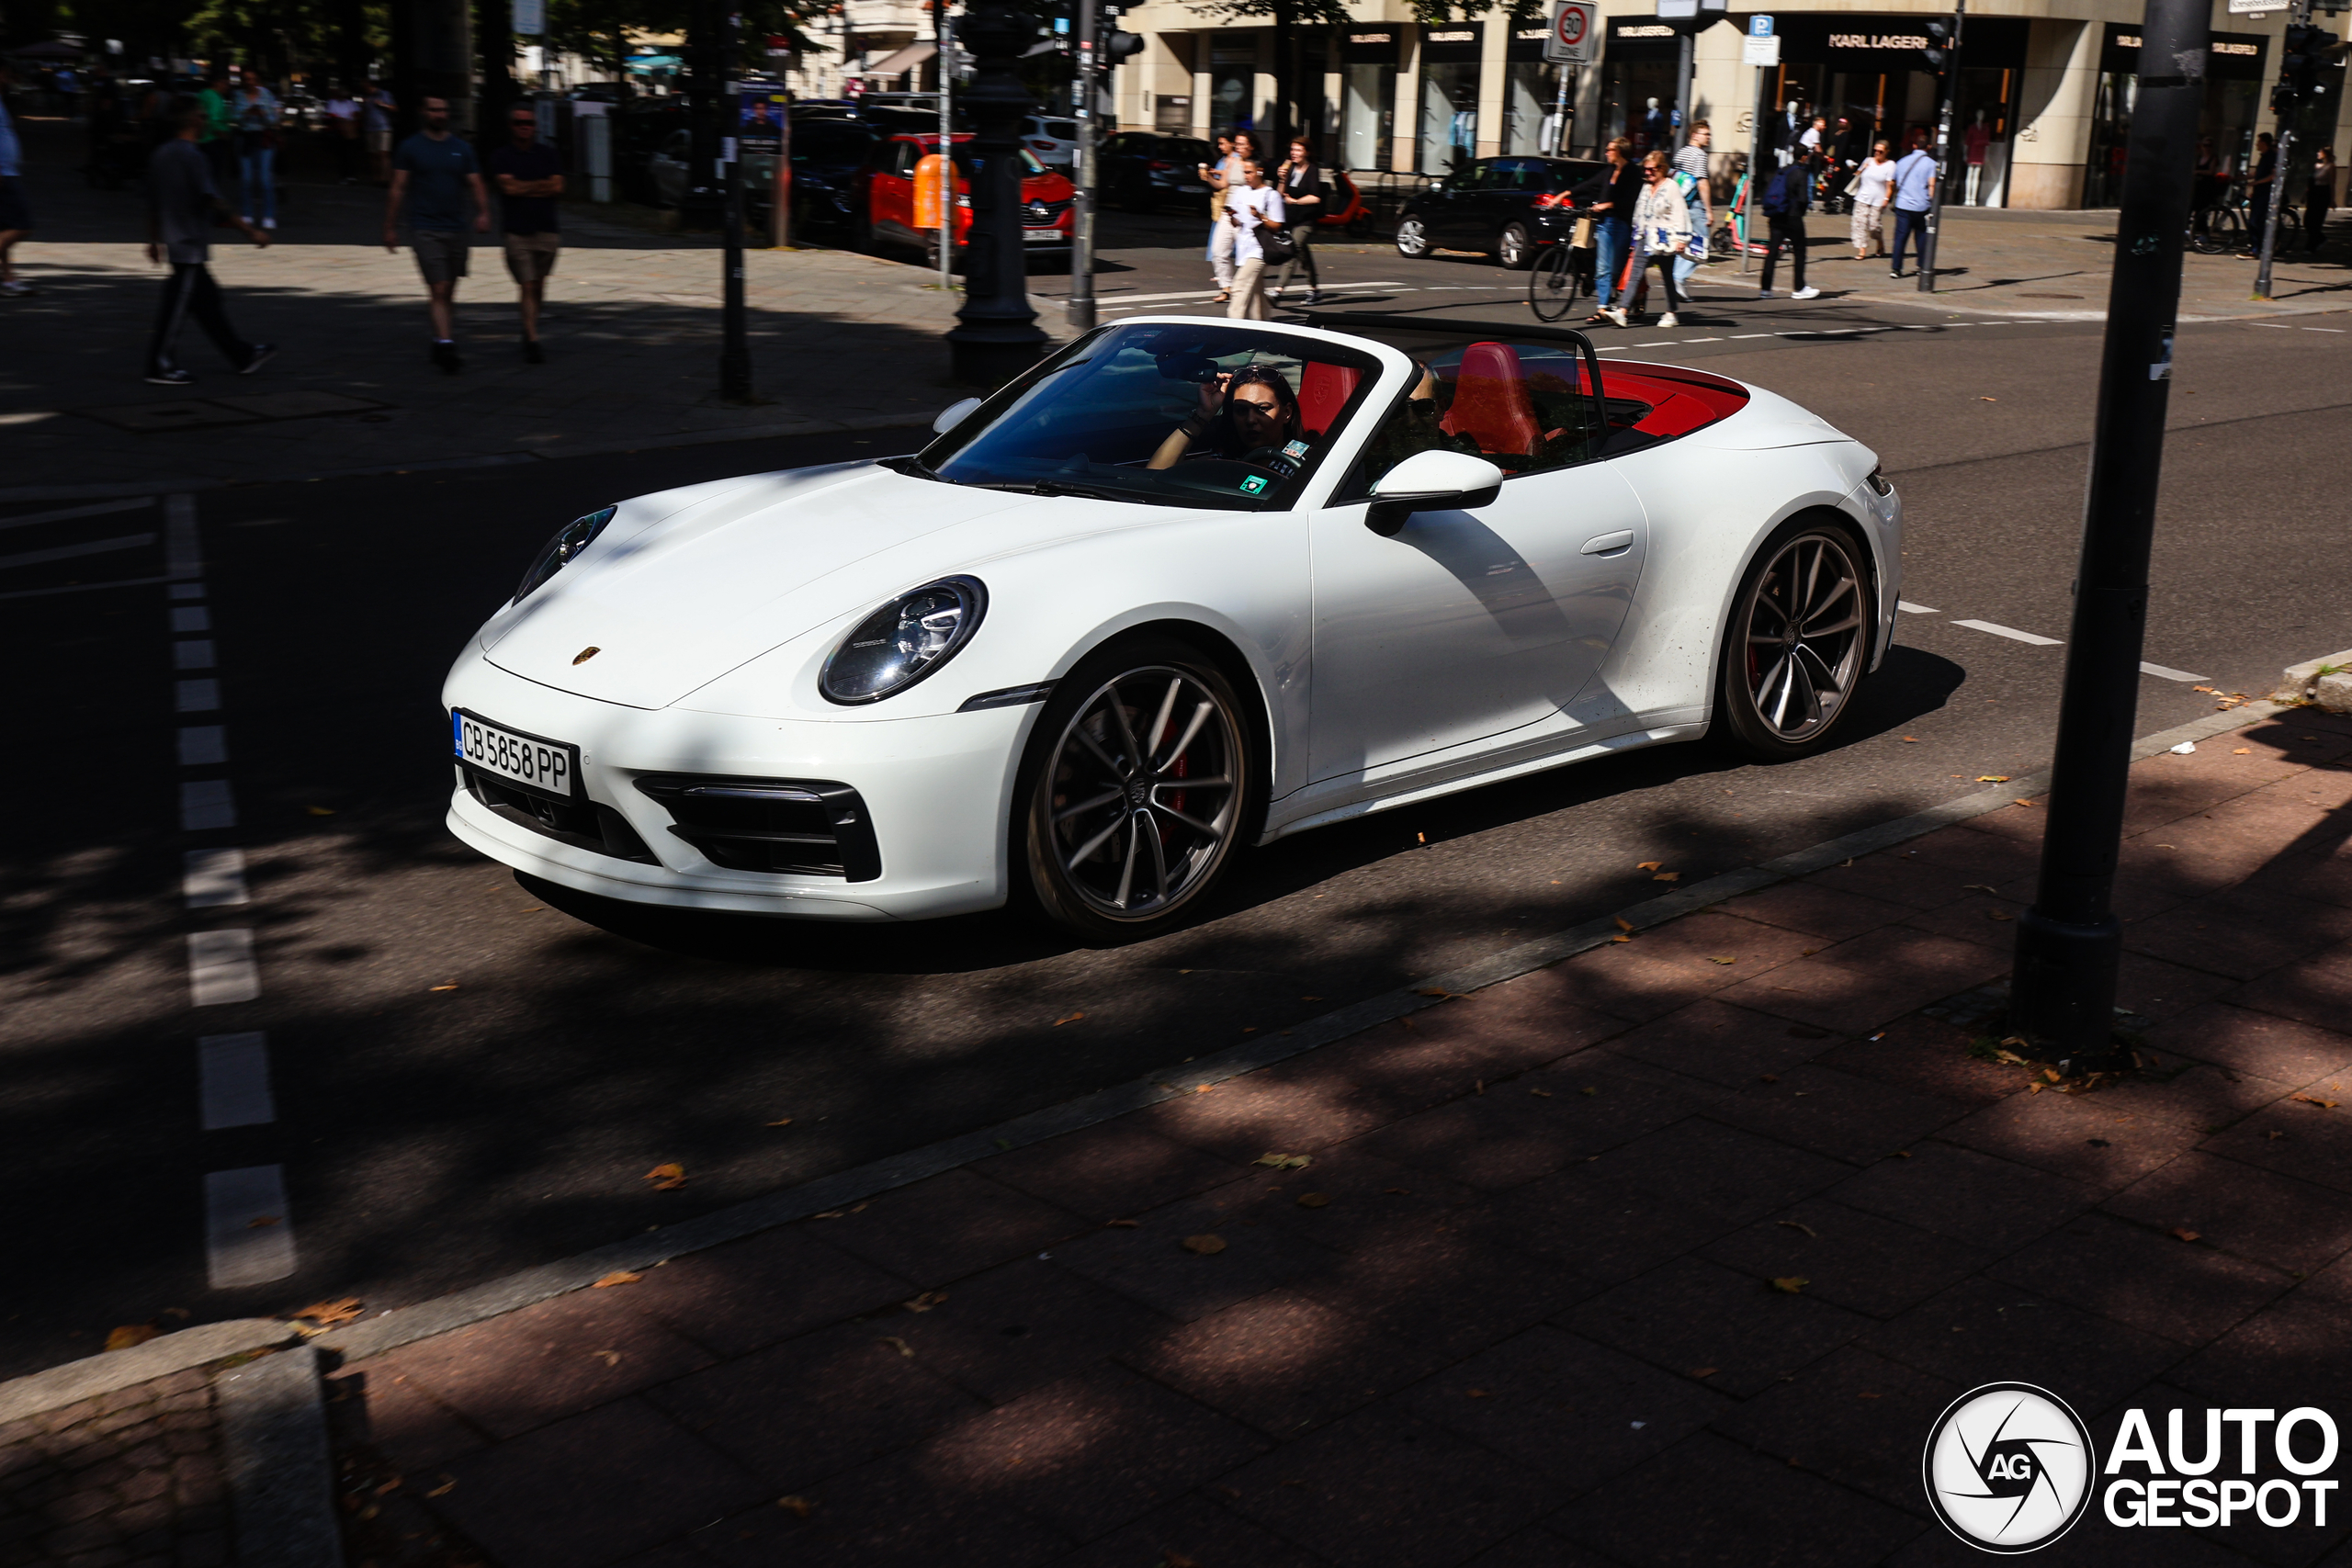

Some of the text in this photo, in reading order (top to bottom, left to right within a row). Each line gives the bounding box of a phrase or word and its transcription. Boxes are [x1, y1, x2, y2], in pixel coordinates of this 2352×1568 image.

[1564, 17, 1581, 34] 30
[1828, 34, 1870, 48] KARL
[1558, 46, 1580, 58] ZONE
[463, 722, 567, 787] CB 5858 PP
